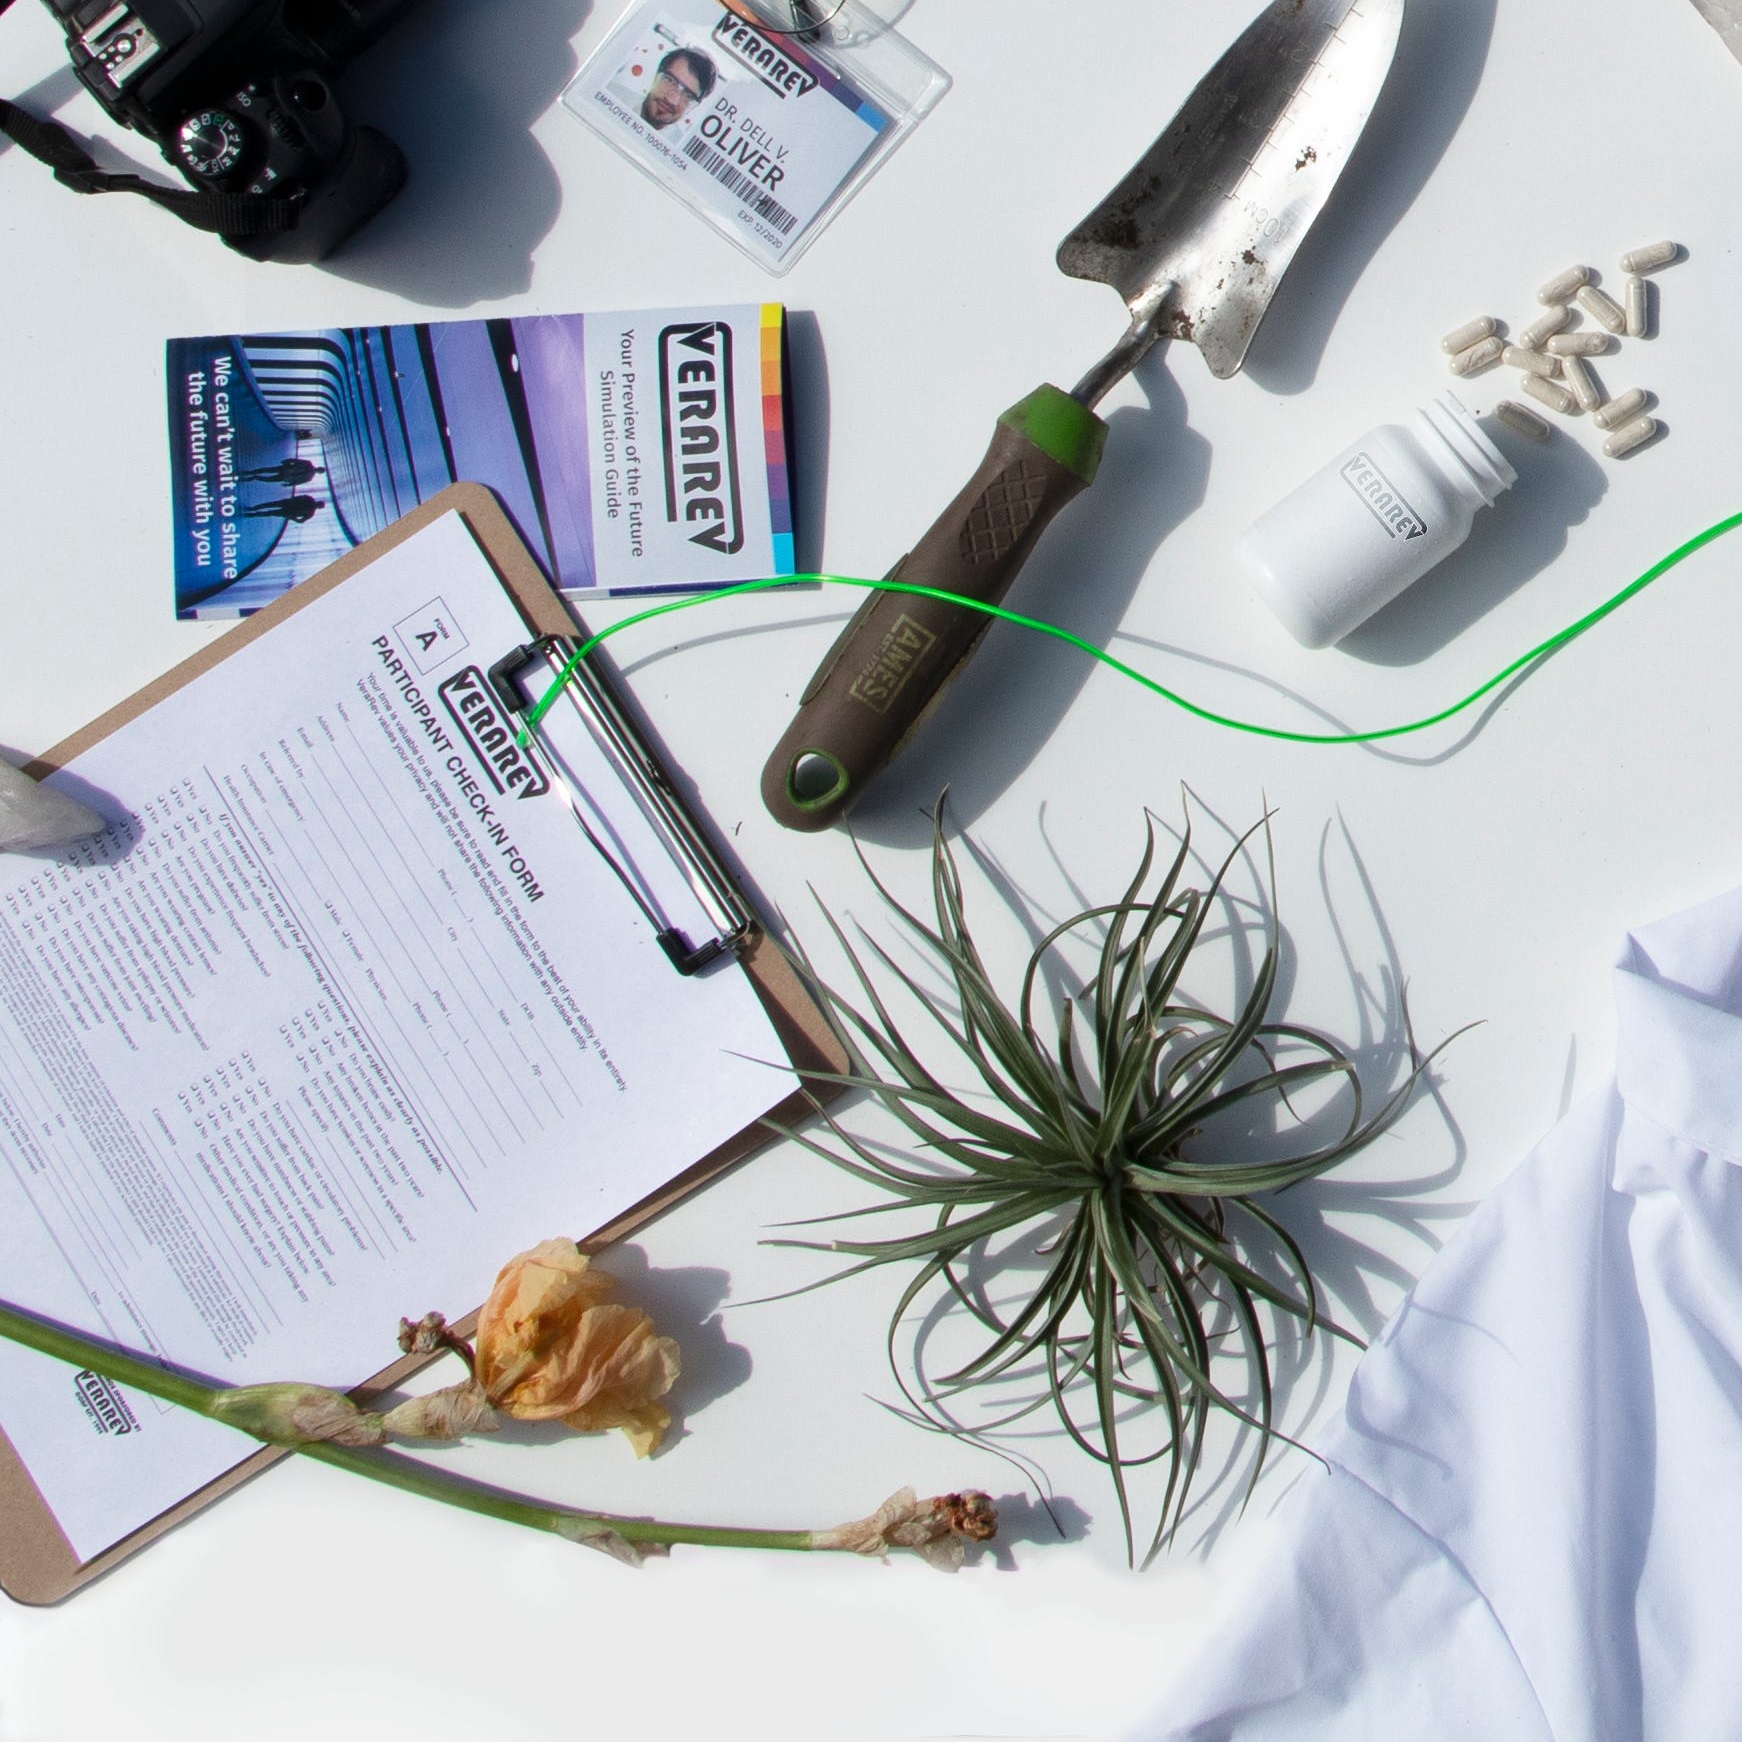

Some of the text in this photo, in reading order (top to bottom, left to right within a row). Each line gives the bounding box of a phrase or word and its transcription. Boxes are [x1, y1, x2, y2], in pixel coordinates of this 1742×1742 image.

[717, 15, 818, 98] VERAREV
[593, 91, 633, 124] EMPLOYEE
[713, 96, 791, 164] DR. DELL V.
[696, 111, 787, 192] OLIVER
[752, 221, 783, 250] 12/2020
[599, 369, 621, 518] Simulation Guide
[619, 329, 644, 557] Your Preview of the Future
[677, 323, 740, 555] VERAREV
[186, 371, 213, 566] the future with you
[211, 356, 242, 579] We can't wait to share
[1347, 454, 1429, 542] VERAREV
[414, 625, 441, 652] A
[432, 617, 450, 640] FORM
[863, 631, 922, 701] AMES
[365, 671, 382, 693] Your
[377, 691, 393, 712] time
[388, 710, 399, 721] is
[393, 719, 421, 756] valuable
[445, 670, 543, 806] VERAREV
[369, 634, 545, 904] PARTICIPANT CHECK-IN FORM
[415, 754, 427, 766] to
[429, 778, 453, 809] please
[447, 806, 461, 820] be
[455, 819, 472, 840] sure
[354, 678, 382, 715] VeraRev
[377, 714, 399, 743] values
[393, 742, 409, 762] your
[405, 761, 429, 793] privacy
[424, 791, 440, 810] and
[435, 808, 449, 825] will
[444, 823, 458, 839] not
[453, 838, 473, 864] share
[468, 861, 482, 878] the
[477, 876, 506, 915] following
[500, 913, 534, 961] information
[528, 959, 545, 979] with
[540, 978, 554, 996] any
[550, 994, 574, 1027] outside
[467, 838, 479, 850] to
[473, 847, 491, 870] read
[485, 867, 502, 887] and
[496, 885, 509, 897] fill
[503, 896, 514, 907] in
[509, 905, 523, 922] the
[518, 919, 536, 942] form
[530, 940, 542, 952] to
[536, 949, 551, 966] the
[545, 964, 563, 985] best
[558, 983, 569, 995] of
[562, 994, 580, 1015] your
[574, 1013, 597, 1040] ability
[592, 1038, 602, 1049] in
[597, 1047, 609, 1060] its
[75, 1368, 130, 1440] VERAREV
